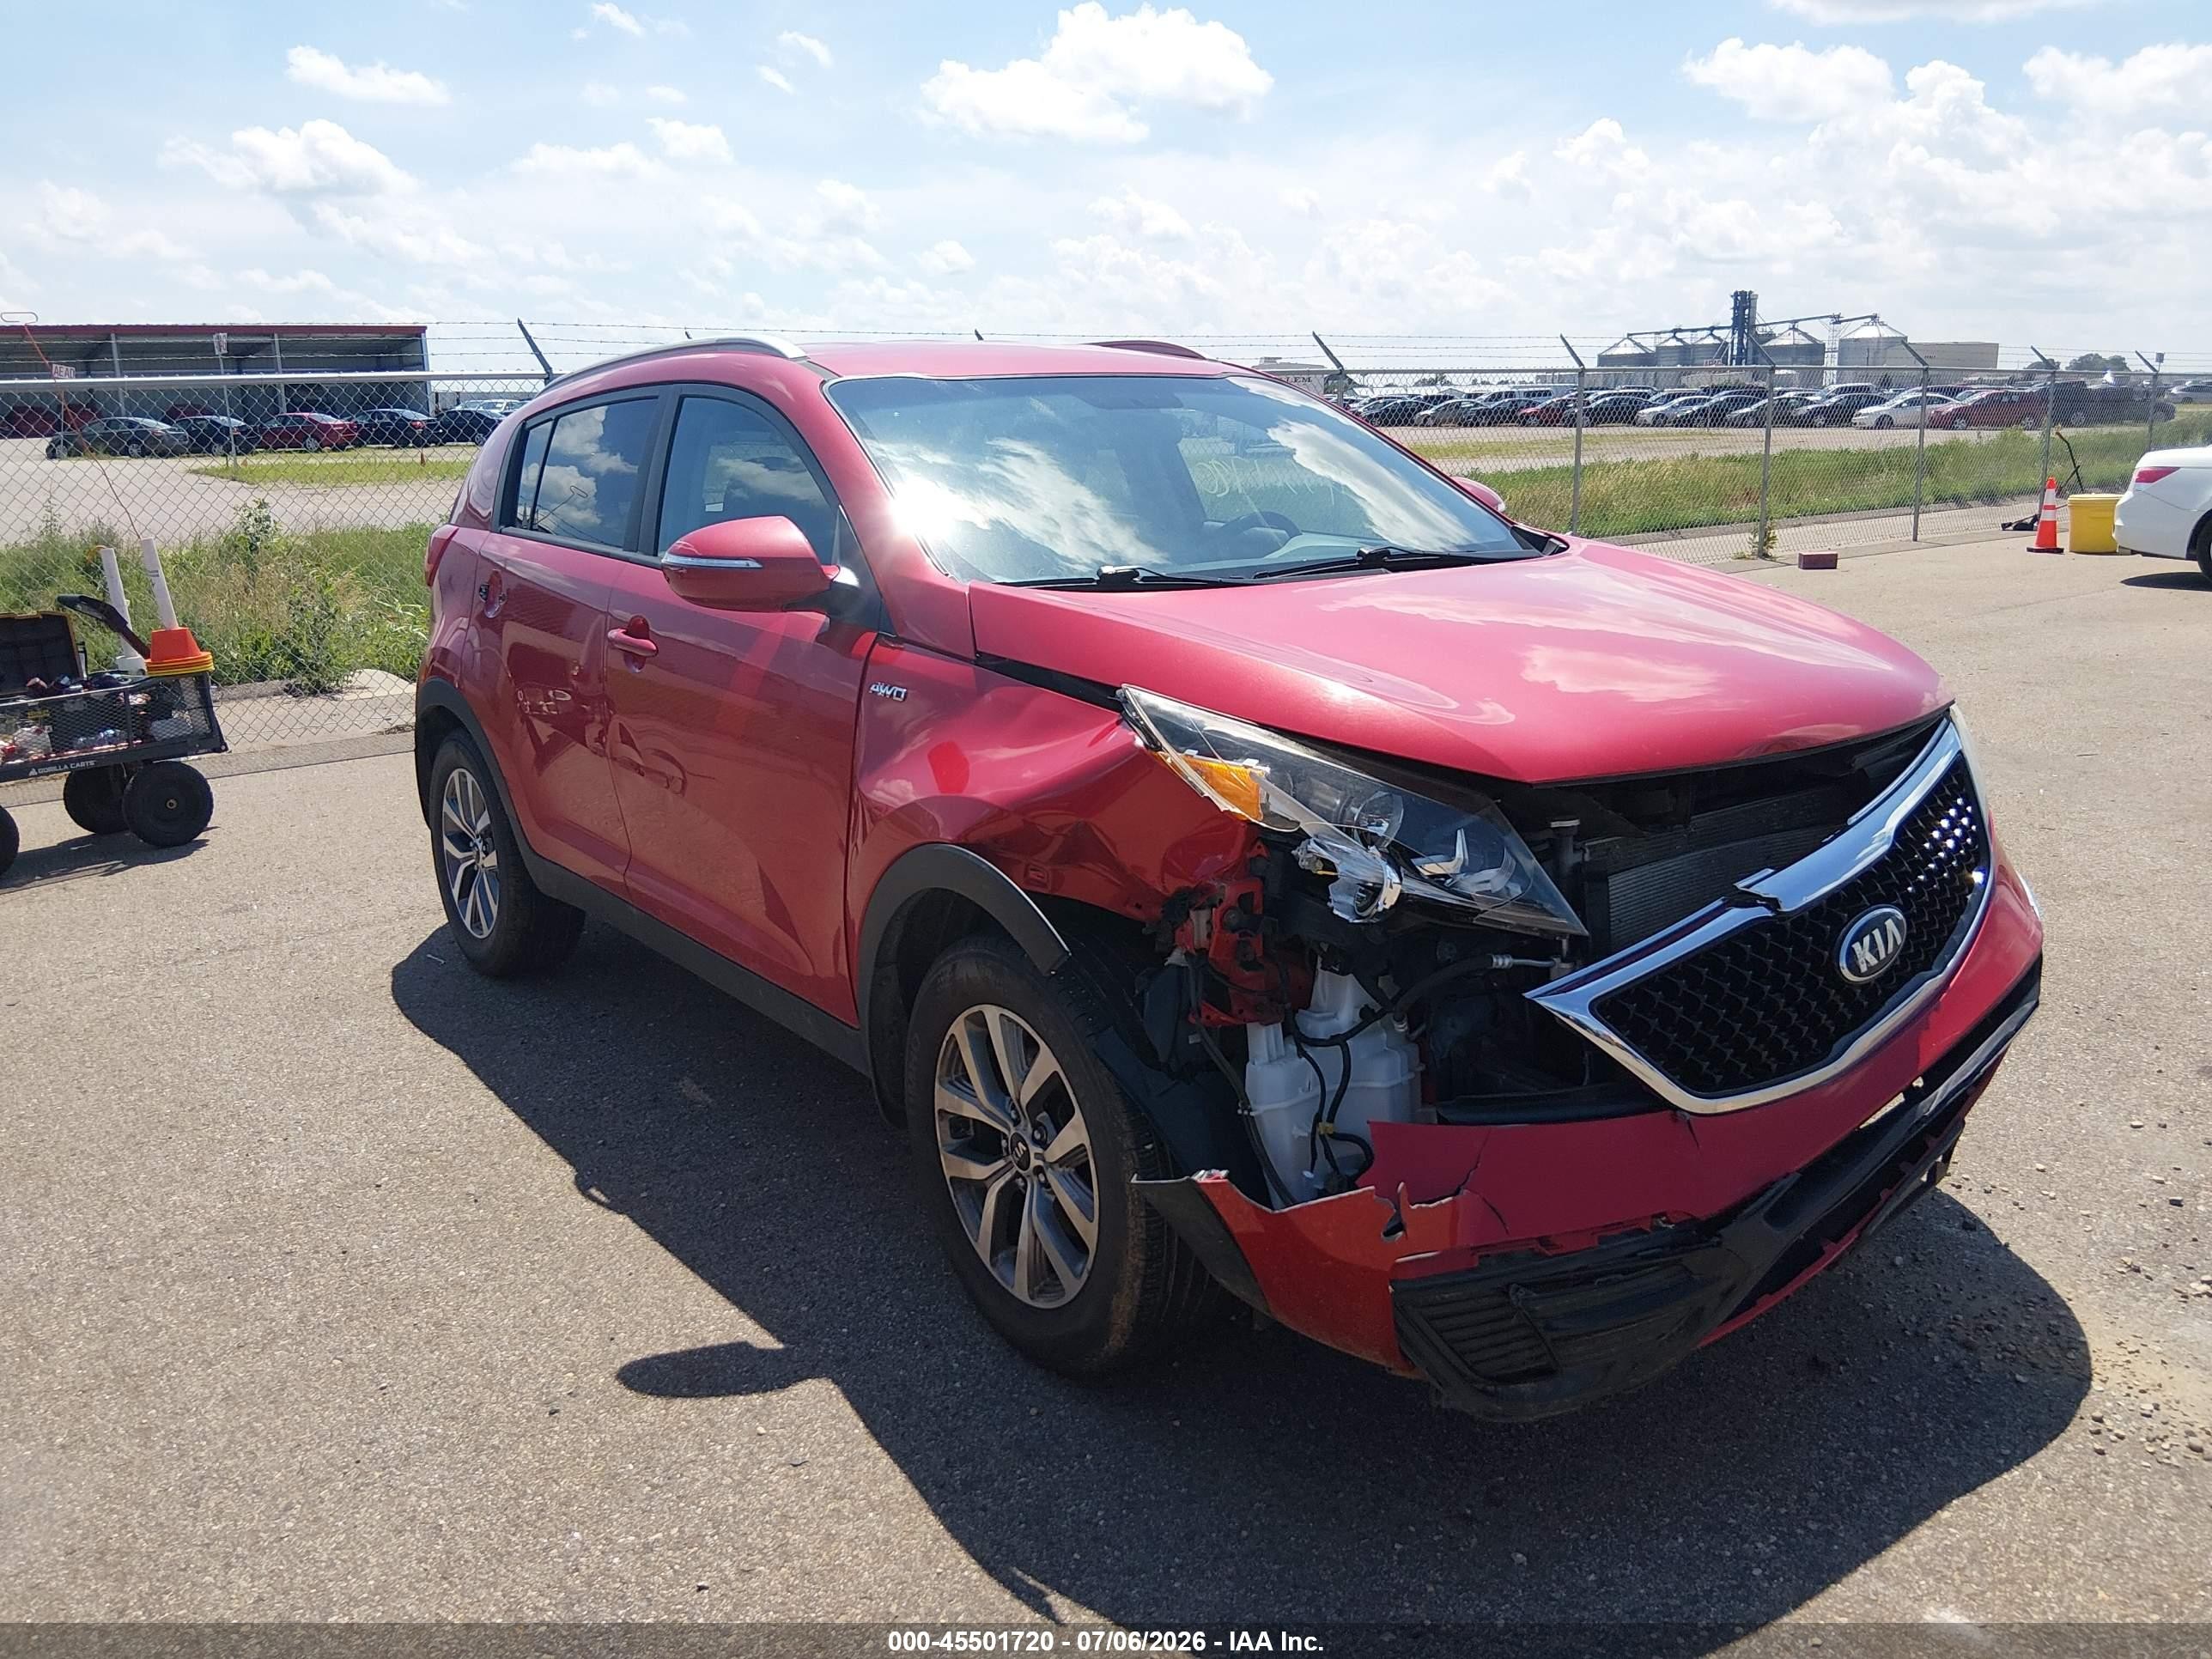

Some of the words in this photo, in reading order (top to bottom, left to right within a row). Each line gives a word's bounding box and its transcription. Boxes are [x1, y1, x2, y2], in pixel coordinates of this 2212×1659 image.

[868, 681, 908, 702] AWD
[37, 763, 70, 774] GORILLA
[70, 760, 95, 769] CARTS
[1851, 918, 1903, 974] KIA
